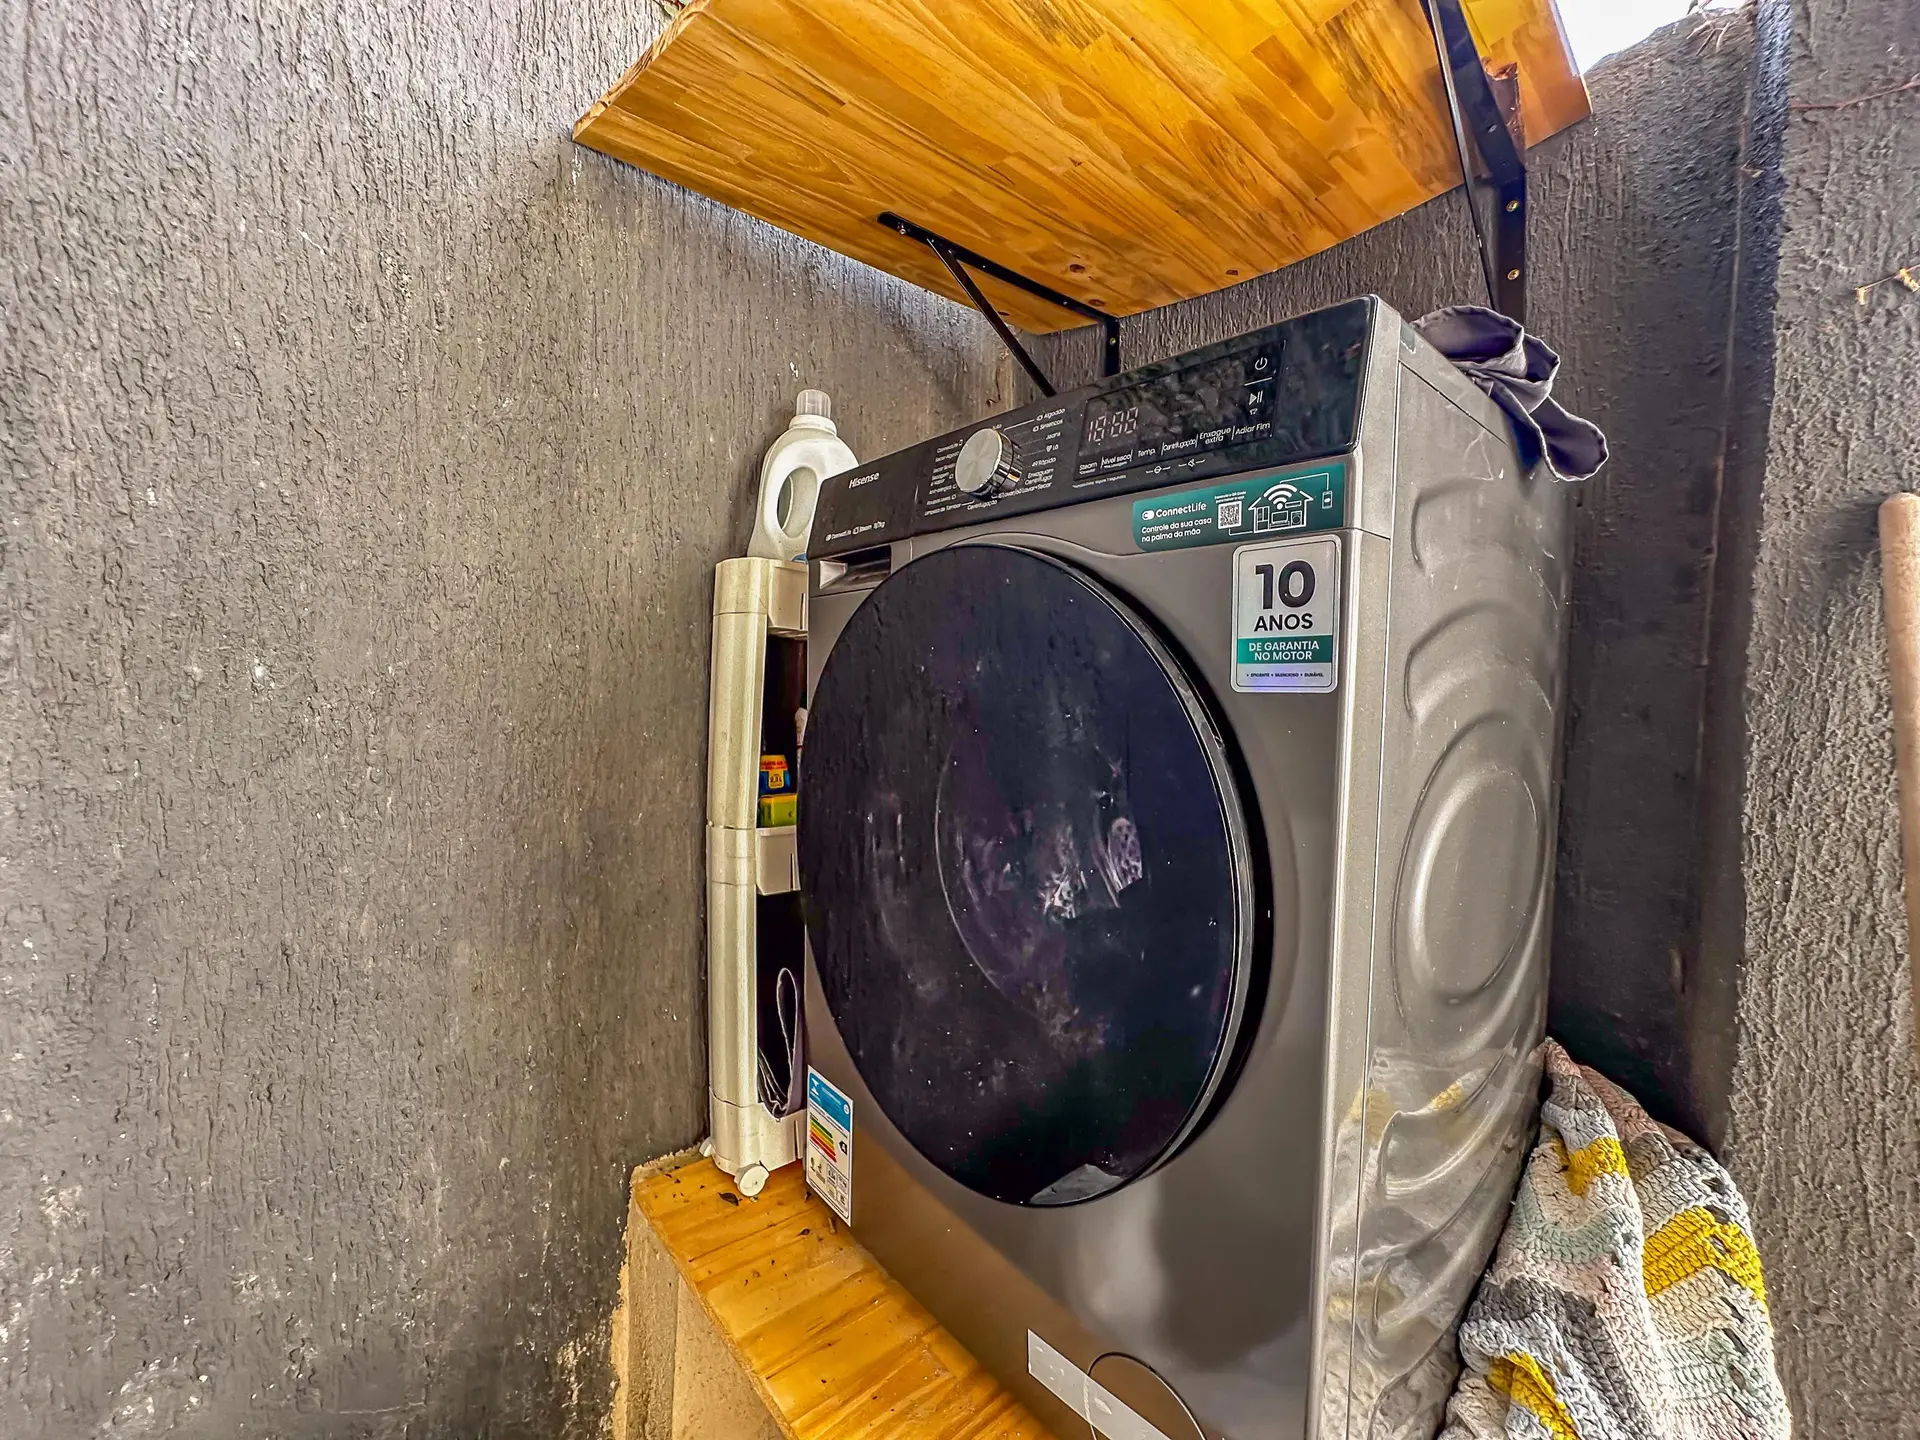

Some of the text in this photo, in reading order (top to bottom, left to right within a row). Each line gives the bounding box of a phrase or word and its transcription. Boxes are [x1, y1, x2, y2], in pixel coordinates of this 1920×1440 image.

[1235, 422, 1271, 436] Adiar Fim
[1205, 435, 1224, 445] extra
[1079, 462, 1098, 471] Steam
[849, 472, 880, 489] Hisense
[1155, 501, 1207, 518] ConnectLife
[1141, 517, 1212, 534] Controle da sua casa
[1151, 532, 1173, 543] palma
[1173, 529, 1184, 538] da
[1184, 527, 1201, 537] mão
[1255, 560, 1316, 610] 10
[1254, 613, 1314, 632] ANOS
[1248, 640, 1320, 652] DE GARANTIA
[1254, 651, 1312, 661] NO MOTOR
